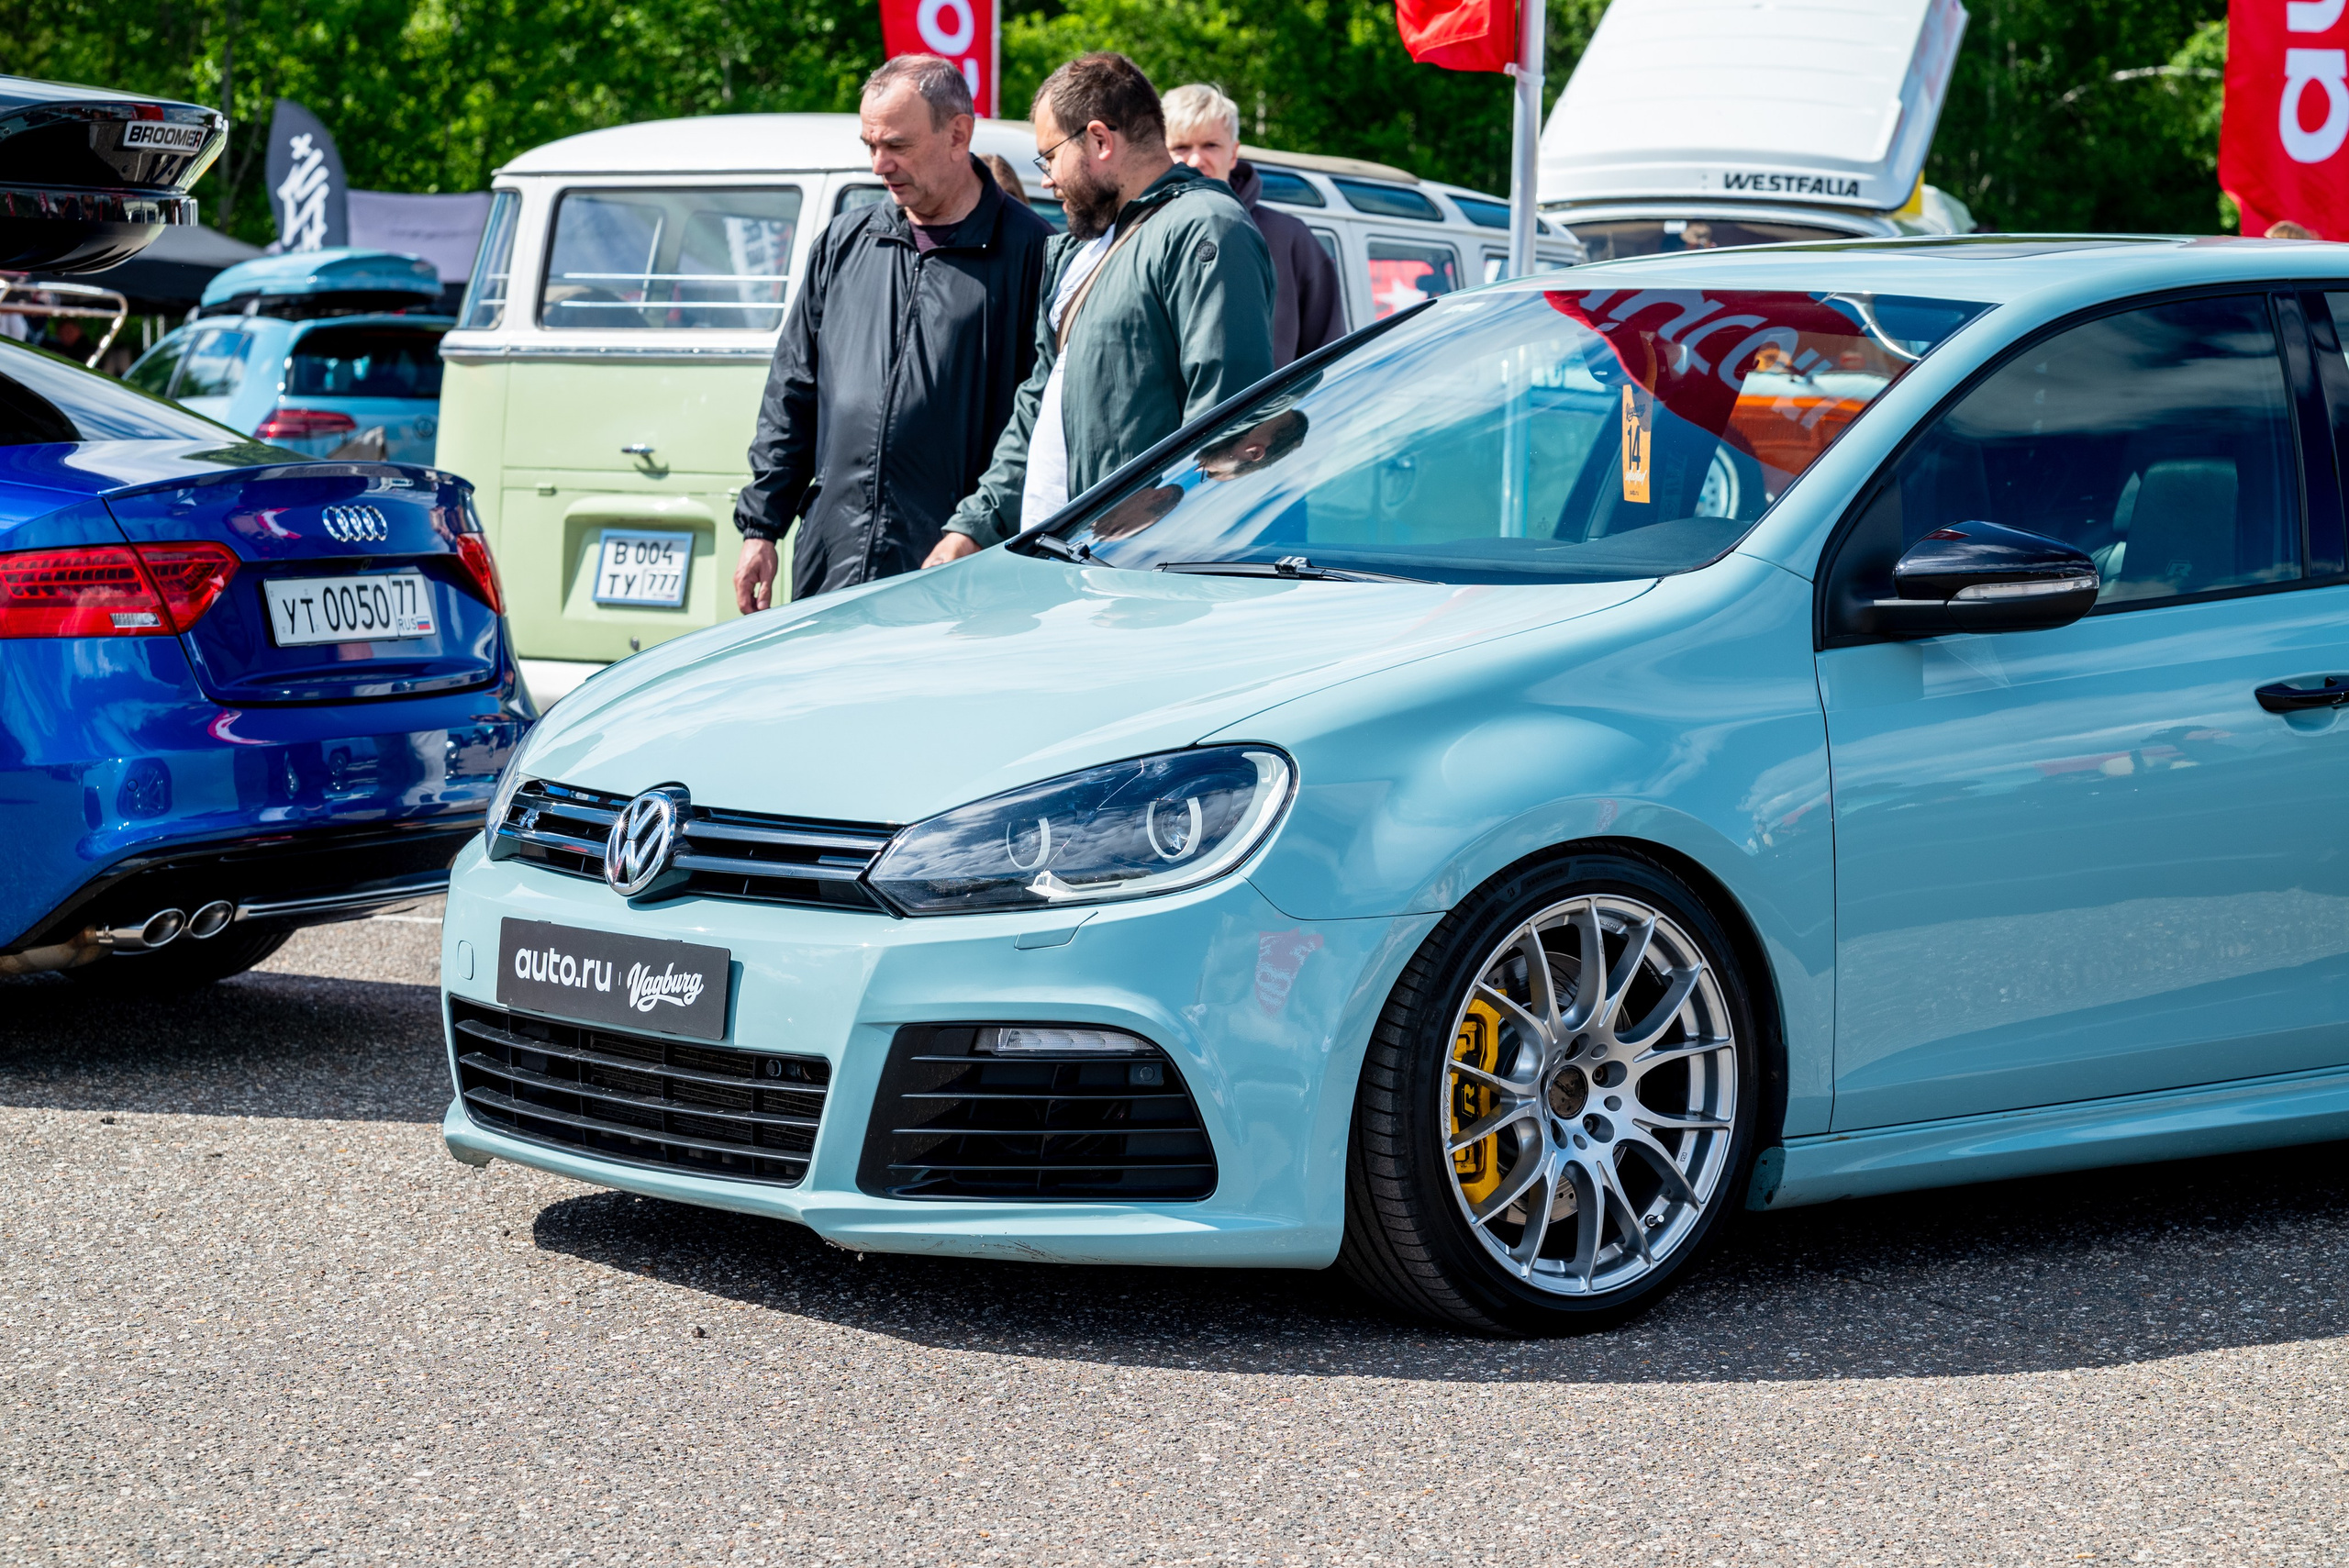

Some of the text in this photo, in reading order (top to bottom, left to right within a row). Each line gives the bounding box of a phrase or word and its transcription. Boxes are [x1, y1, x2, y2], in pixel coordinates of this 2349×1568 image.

[128, 125, 203, 148] BROOMER
[1724, 172, 1860, 197] WESTFALIA
[1628, 424, 1642, 470] 14
[635, 541, 674, 565] 004
[649, 573, 680, 591] 777
[323, 584, 390, 631] 0050
[392, 580, 417, 615] 77
[398, 617, 417, 630] RUS
[1437, 906, 1499, 991] BRIDGESTONE
[515, 947, 705, 1012] auto.ru Vagburg
[1461, 1084, 1475, 1118] R
